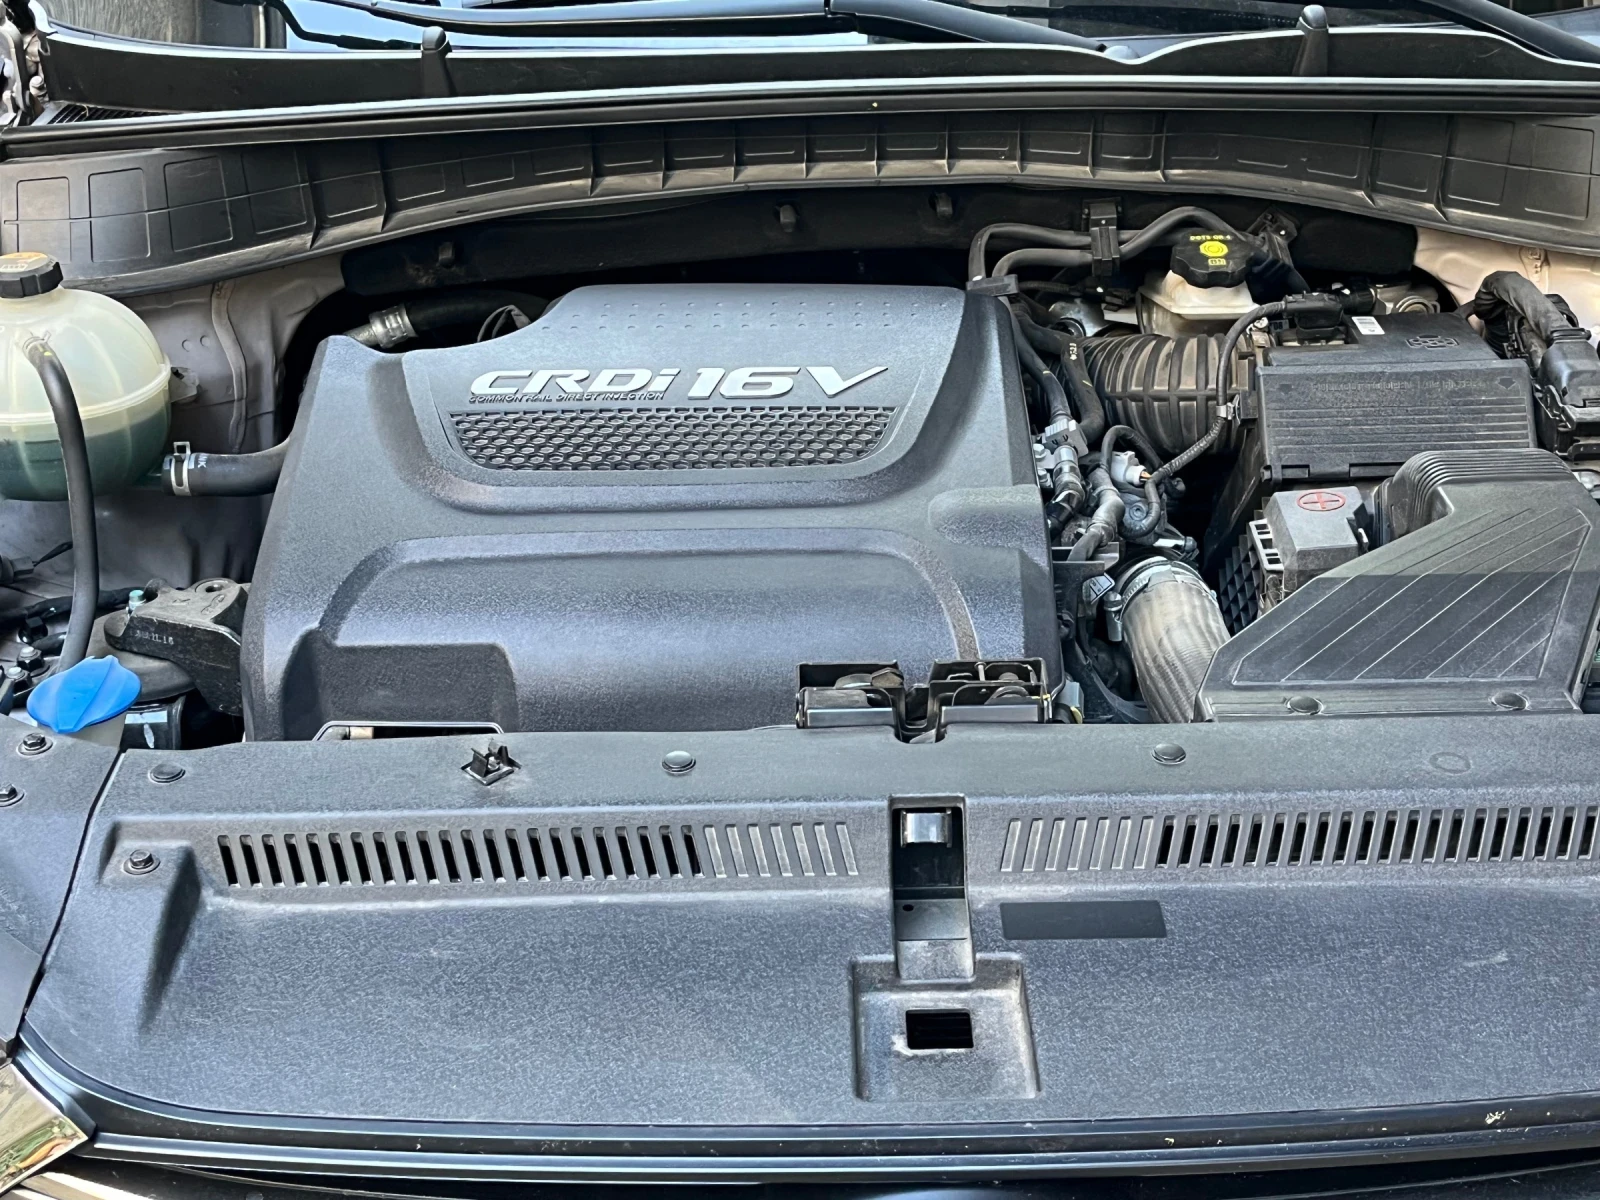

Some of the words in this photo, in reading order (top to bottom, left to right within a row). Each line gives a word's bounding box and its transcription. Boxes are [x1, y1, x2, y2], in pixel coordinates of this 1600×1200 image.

[470, 368, 681, 395] CRDi
[469, 393, 523, 404] COMMON
[524, 393, 553, 403] RAIL
[555, 392, 600, 402] DIRECT
[600, 391, 665, 401] INJECTION
